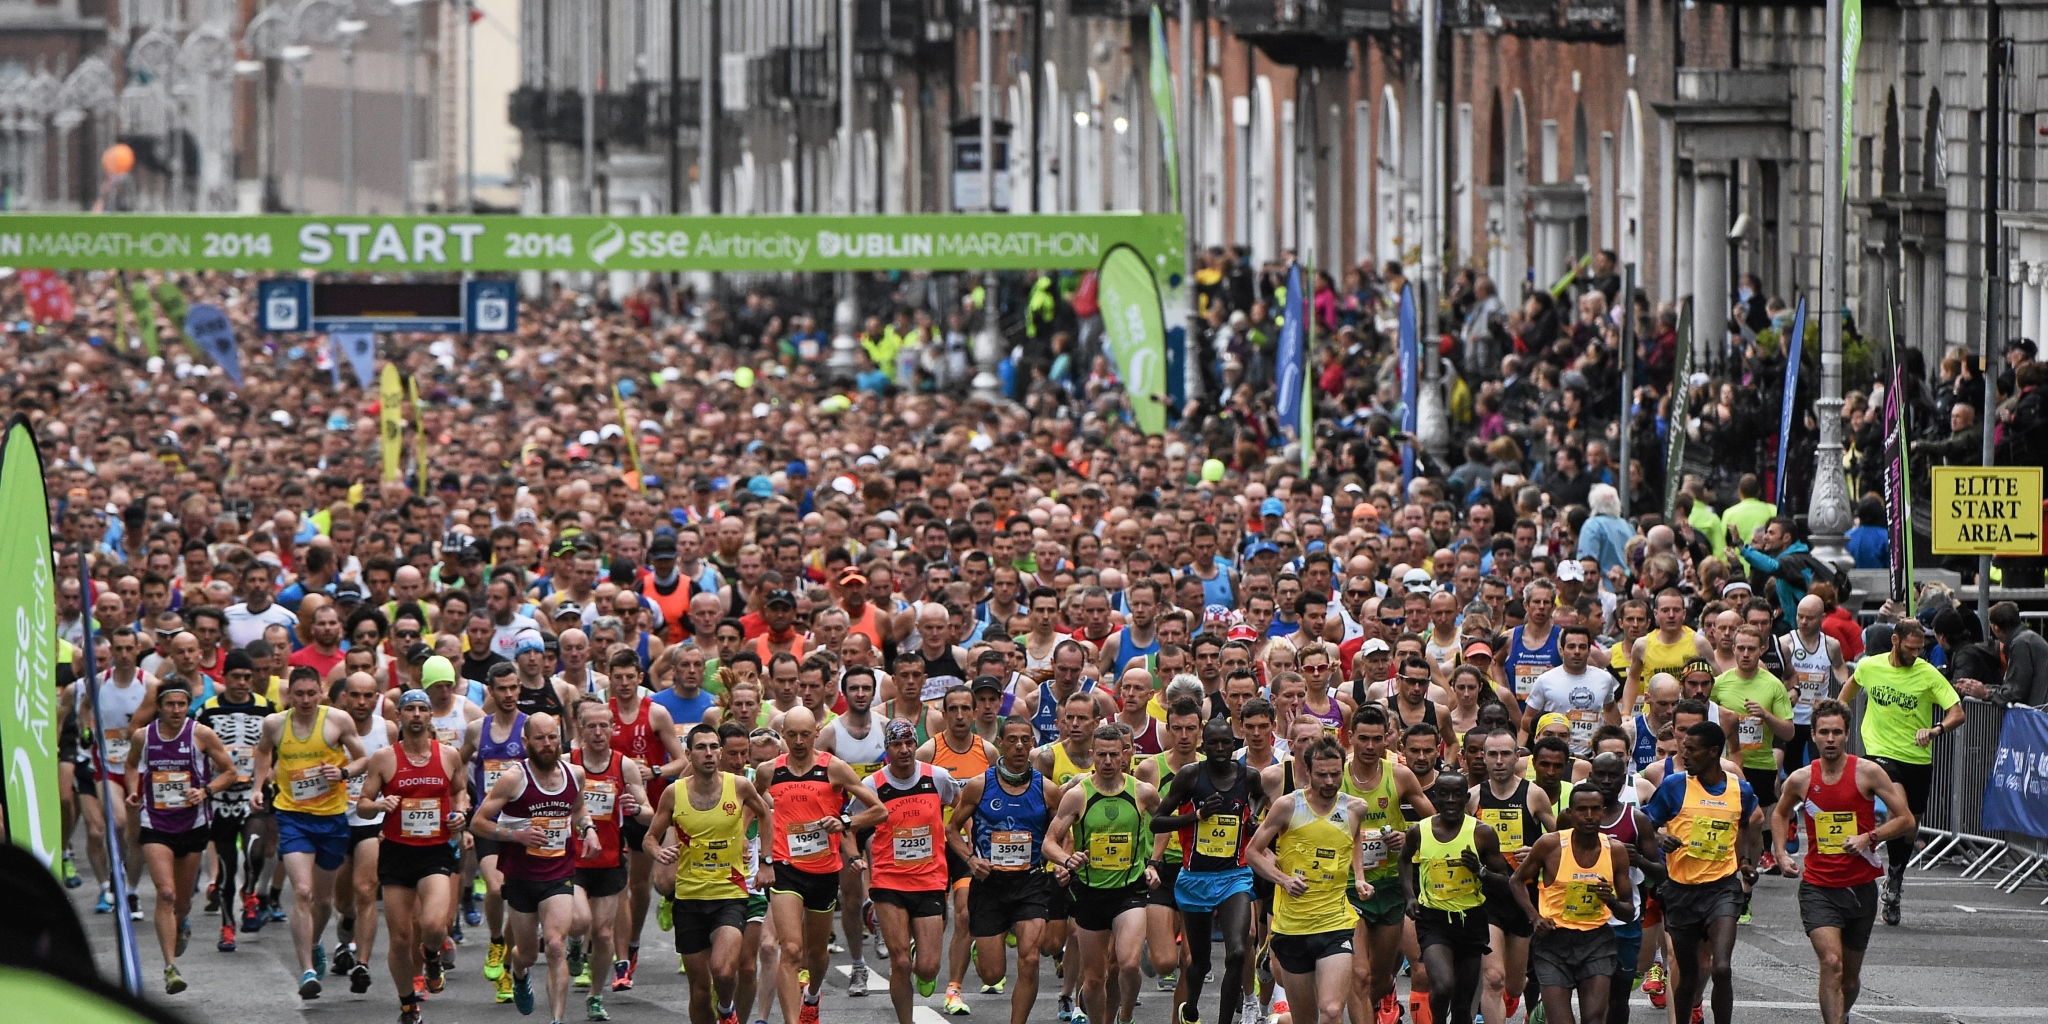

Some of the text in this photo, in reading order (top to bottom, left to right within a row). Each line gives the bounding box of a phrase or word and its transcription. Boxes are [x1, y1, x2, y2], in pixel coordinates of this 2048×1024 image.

[28, 233, 190, 257] MARATHON
[203, 234, 272, 257] 2014
[299, 223, 486, 265] START
[504, 234, 573, 257] 2014
[629, 231, 690, 256] sse
[694, 231, 810, 265] Airtricity
[817, 231, 933, 257] DUBLIN
[936, 232, 1099, 256] MARATHON
[1954, 477, 2018, 496] ELITE
[1951, 500, 2022, 519] START
[1957, 524, 2013, 542] AREA
[30, 534, 48, 757] Airtricity
[16, 605, 29, 731] sse
[1571, 719, 1593, 727] 1148
[158, 783, 185, 792] 3043
[297, 778, 321, 789] 2331
[398, 777, 444, 788] DOONEEN
[777, 783, 822, 799] MARIOLO'S
[888, 797, 933, 815] MARIOLO'S
[408, 811, 434, 820] 6778
[903, 809, 920, 819] PUB
[1495, 823, 1508, 832] 18
[1829, 825, 1843, 835] 22
[795, 832, 820, 843] 1950
[1212, 828, 1226, 838] 66
[1706, 831, 1717, 841] 11
[900, 837, 926, 848] 2230
[998, 844, 1025, 853] 3594
[1105, 846, 1117, 855] 15
[703, 852, 718, 861] 24
[1312, 861, 1319, 869] 2
[1446, 870, 1454, 879] 7
[1581, 895, 1593, 904] 12
